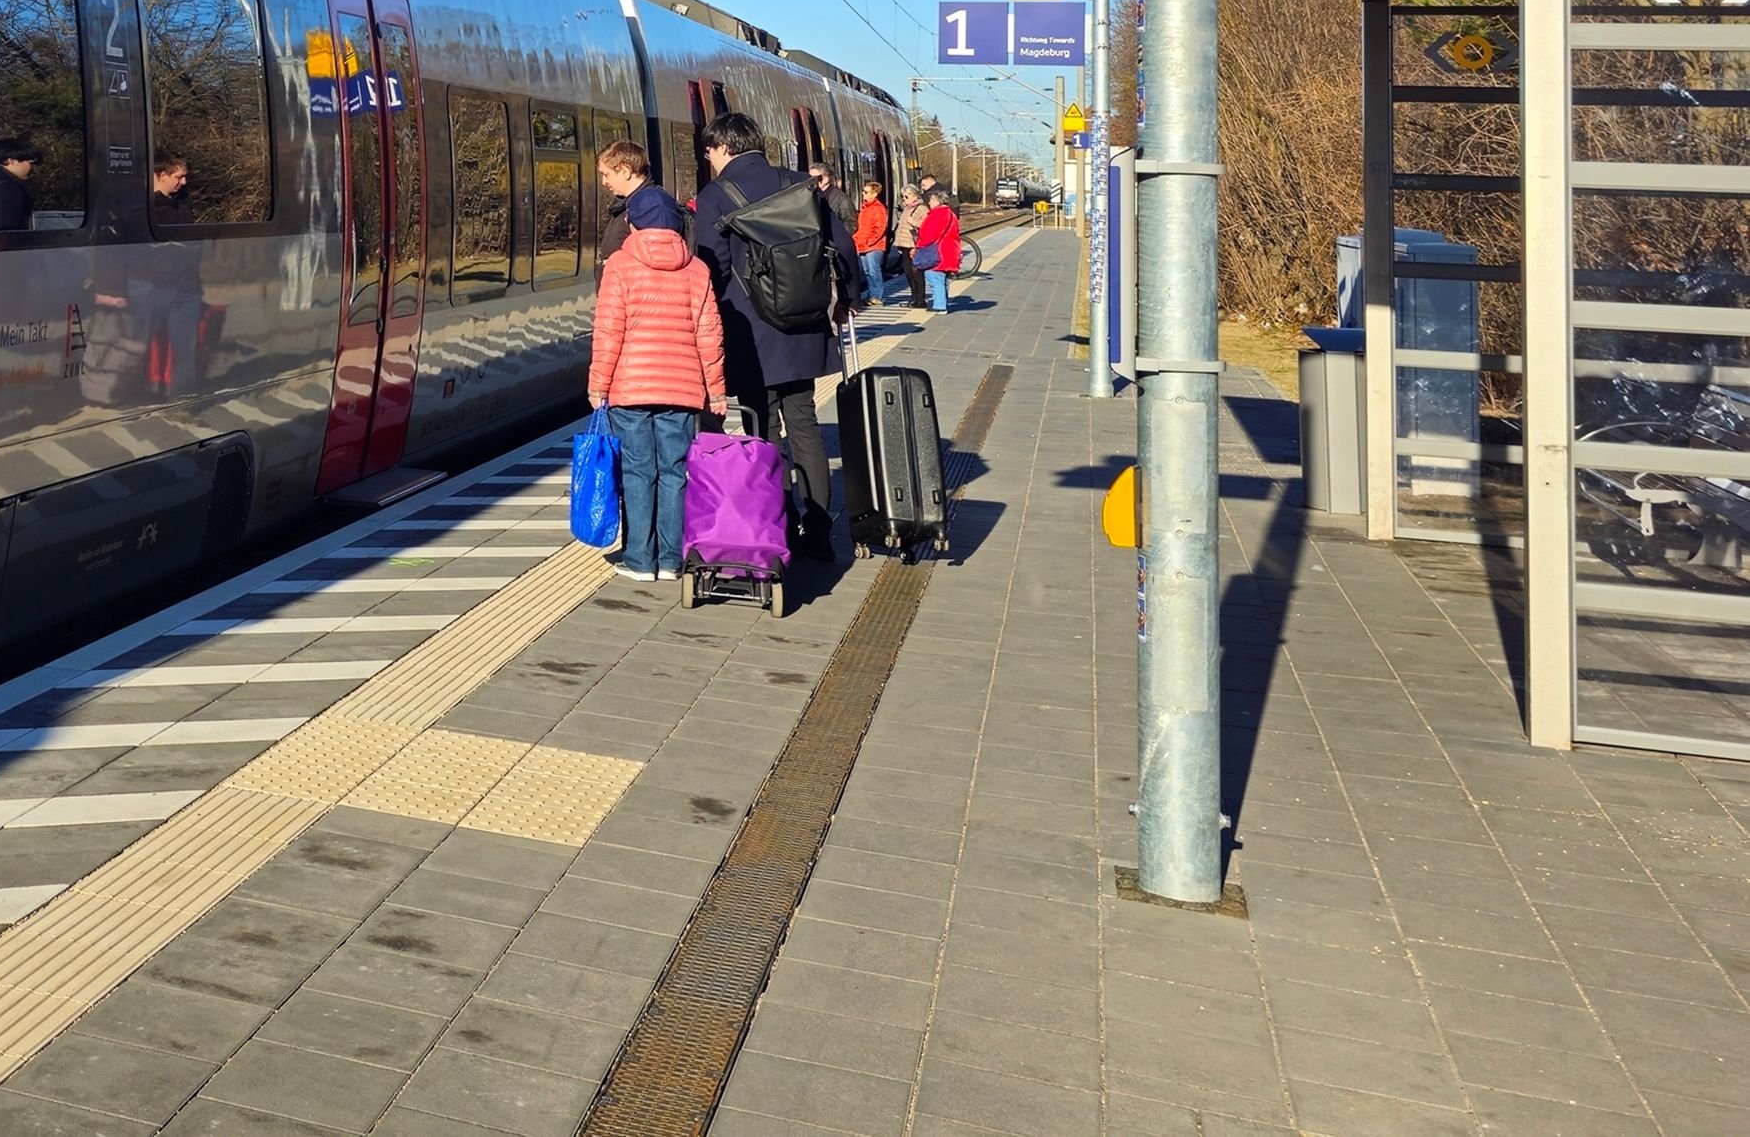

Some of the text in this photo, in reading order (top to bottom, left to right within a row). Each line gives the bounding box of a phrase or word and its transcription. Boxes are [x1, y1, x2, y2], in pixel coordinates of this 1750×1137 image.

[945, 9, 975, 56] 1
[1020, 48, 1070, 58] Magdeburg
[1073, 134, 1082, 147] 1
[0, 319, 48, 348] Mein Takt
